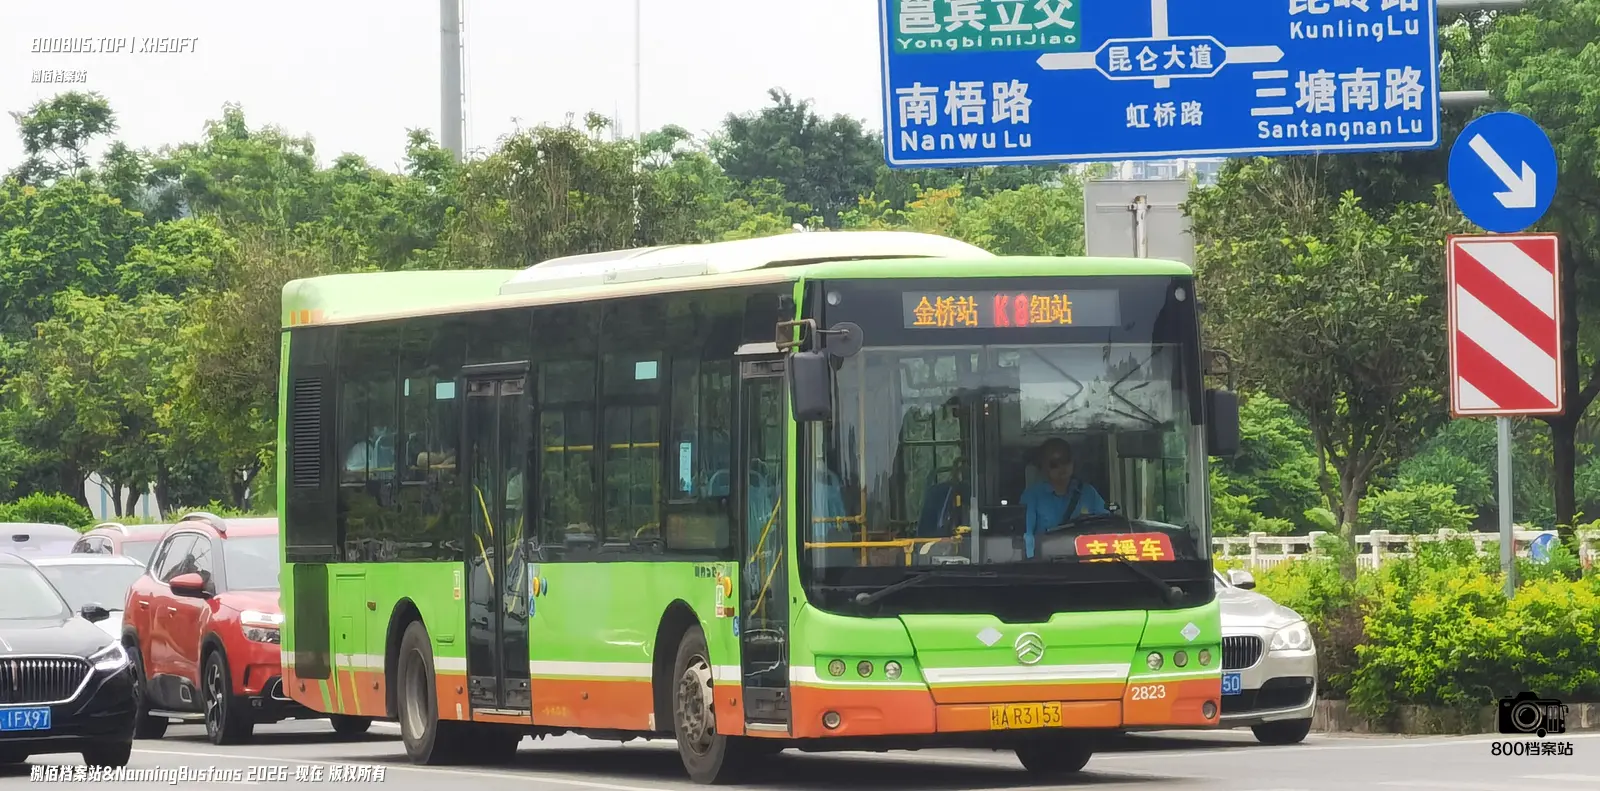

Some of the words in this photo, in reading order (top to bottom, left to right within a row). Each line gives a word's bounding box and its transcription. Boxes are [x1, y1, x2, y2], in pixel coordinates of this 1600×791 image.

[899, 0, 1076, 34] 邕宾立交
[1109, 44, 1213, 72] 昆仑大道
[895, 79, 1032, 128] 南梧路
[1250, 66, 1425, 116] 三塘南路
[1126, 100, 1203, 128] 虹桥路
[912, 296, 978, 326] 金桥站
[1086, 538, 1164, 562] 支援车
[1131, 685, 1166, 700] 2823
[0, 710, 49, 729] 1FX97
